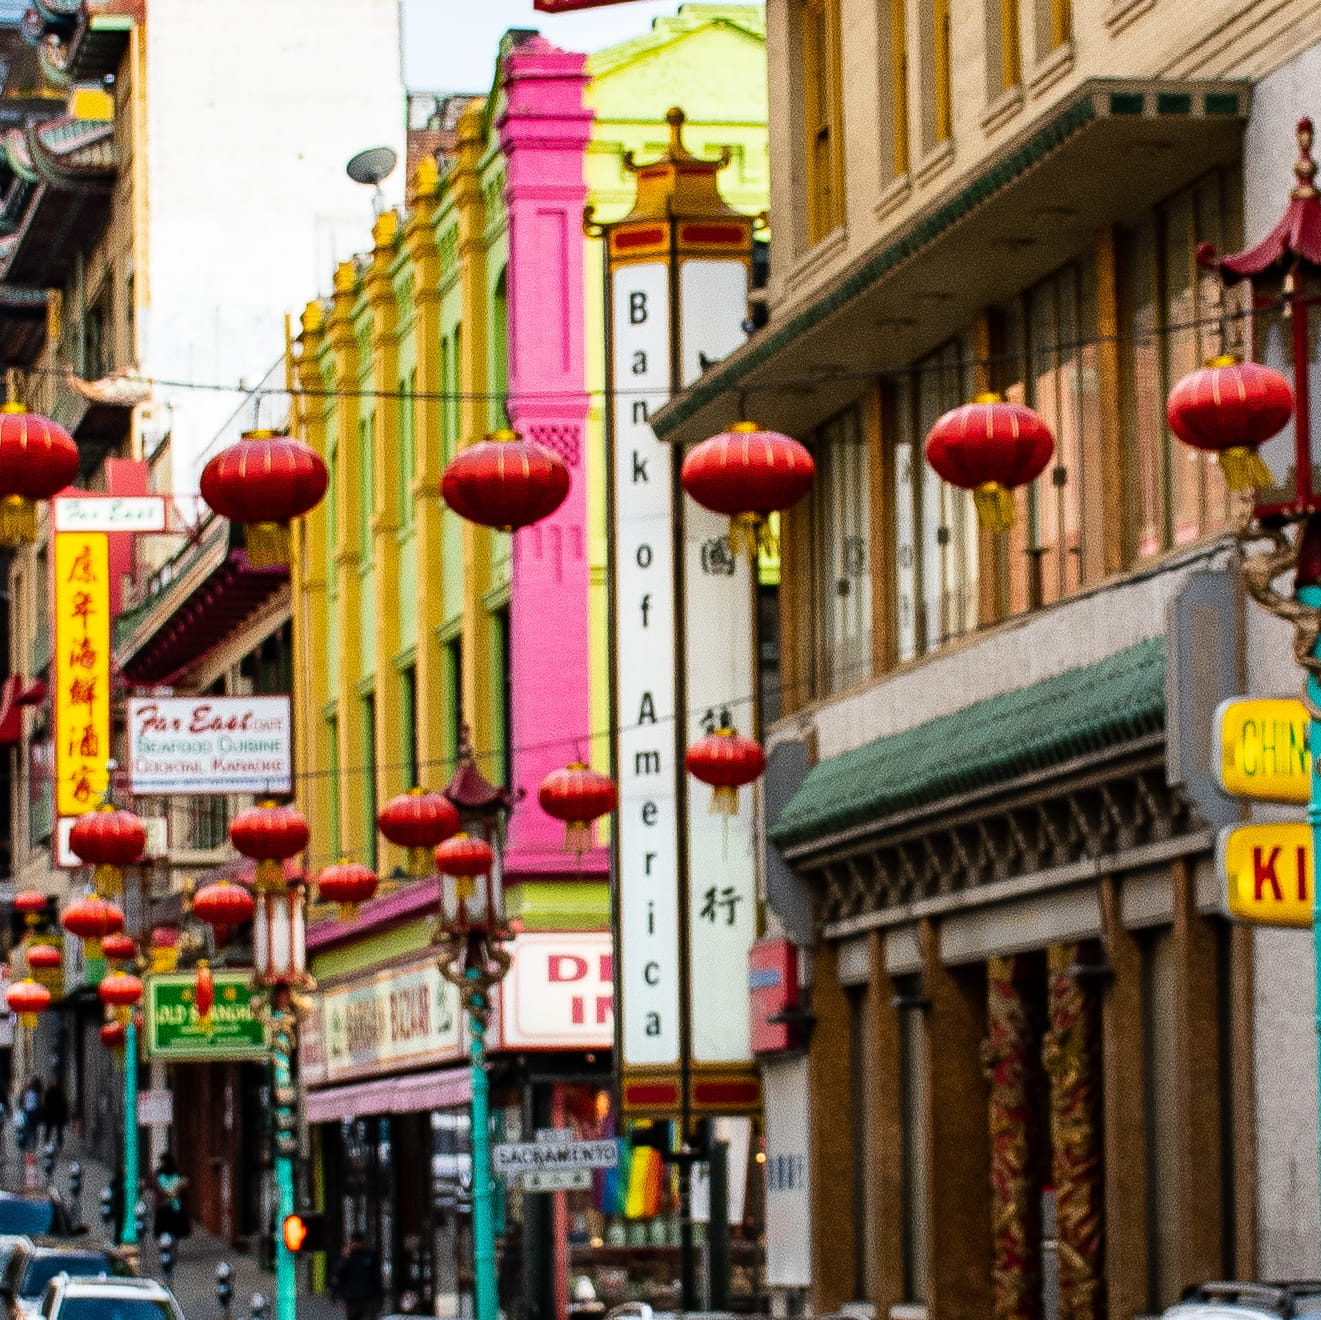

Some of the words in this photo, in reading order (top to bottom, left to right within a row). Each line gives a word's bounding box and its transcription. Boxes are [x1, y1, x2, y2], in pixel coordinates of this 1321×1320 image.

[627, 290, 649, 484] Bank
[636, 543, 652, 628] of
[136, 703, 183, 736] Far
[189, 703, 254, 735] East
[635, 691, 662, 1038] America
[499, 1145, 616, 1165] SACRAMENTO
